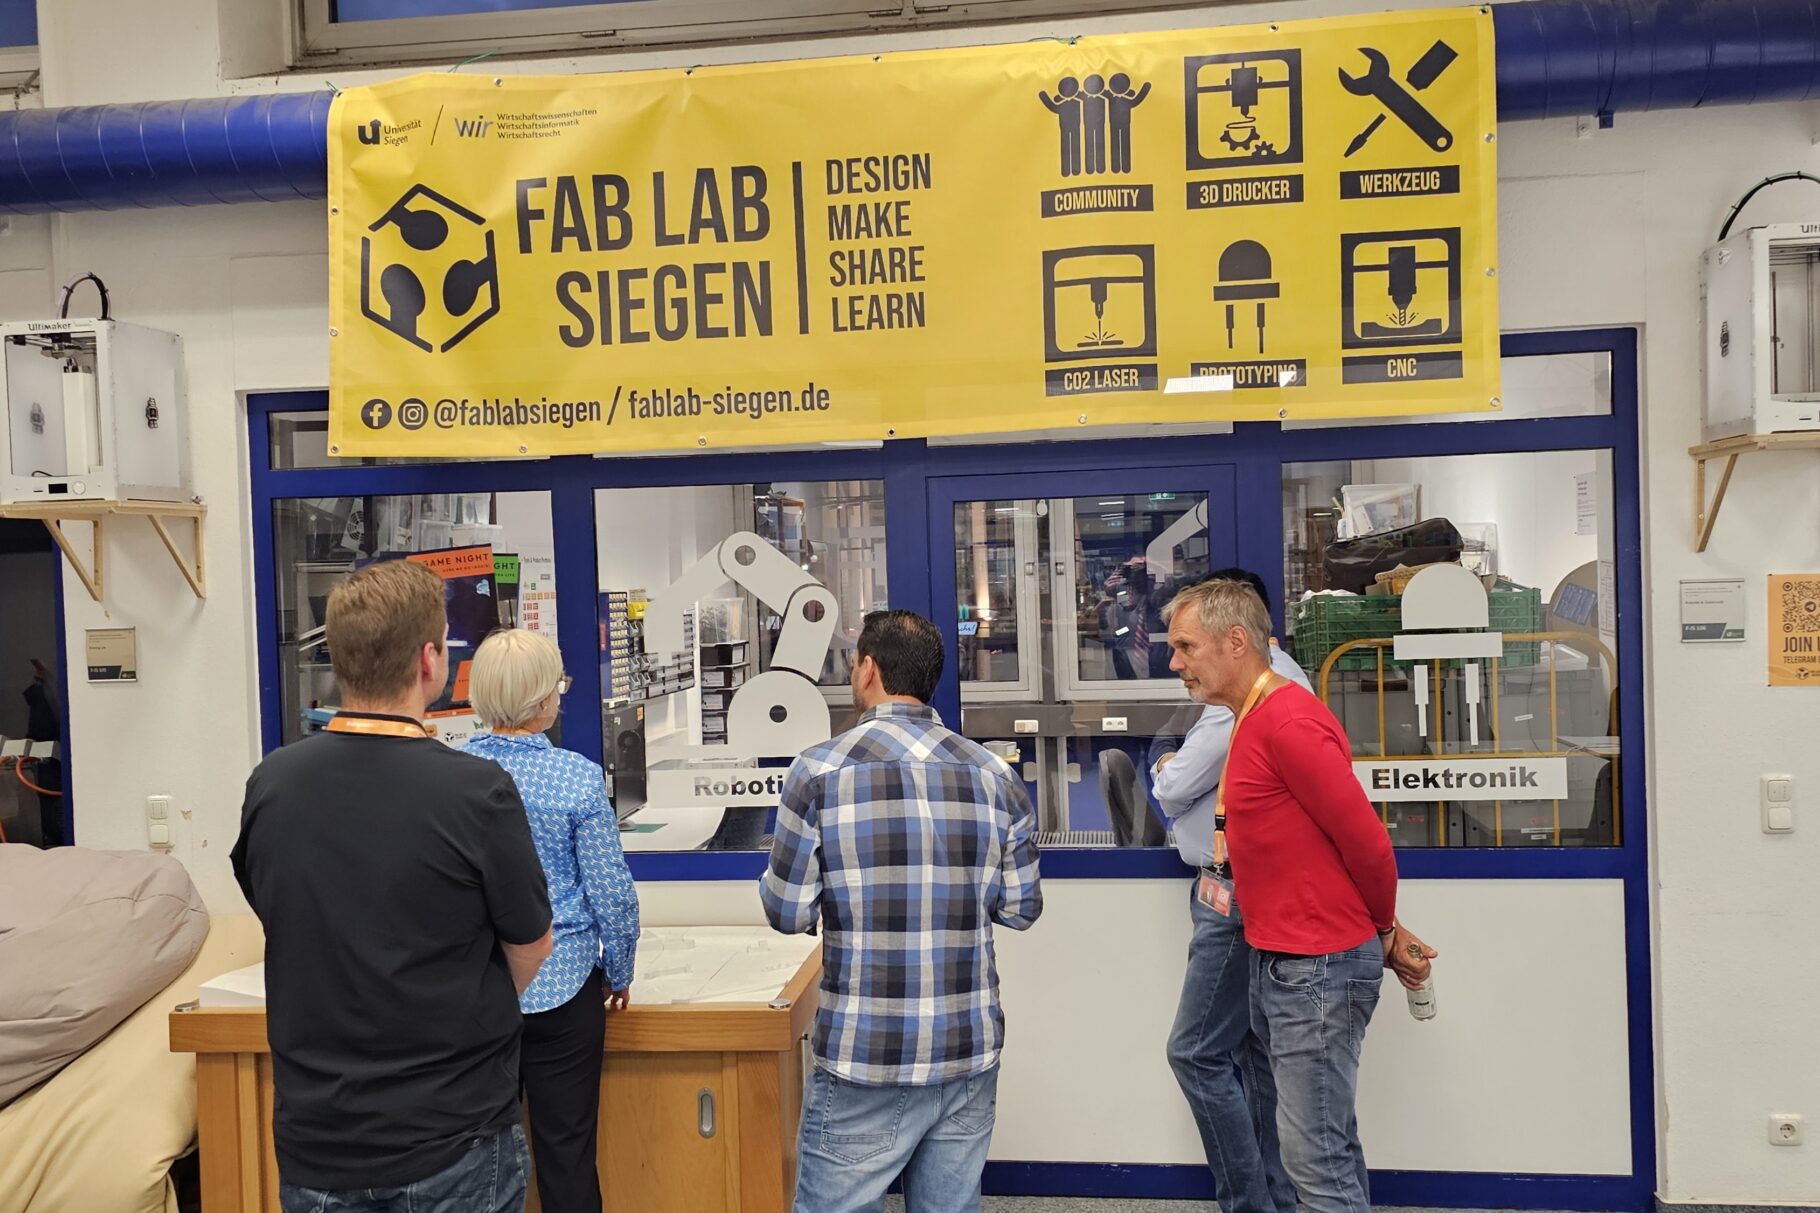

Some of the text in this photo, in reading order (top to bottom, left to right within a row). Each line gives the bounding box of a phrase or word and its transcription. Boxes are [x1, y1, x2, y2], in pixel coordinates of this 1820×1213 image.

[496, 108, 598, 122] Wirtschaftswissenschaften
[496, 118, 580, 131] Wirtschaftsinformatik
[383, 119, 422, 135] Universität
[496, 129, 561, 140] Wirtschaftsrecht
[383, 135, 409, 147] Siegen
[825, 152, 932, 196] DESIGN
[1359, 171, 1441, 194] WERKZEUG
[1053, 188, 1140, 212] COMMUNITY
[1199, 180, 1291, 204] 3D DRUCKER
[516, 164, 771, 255] FAB LAB
[827, 200, 912, 242] MAKE
[829, 245, 926, 287] SHARE
[555, 260, 774, 349] SIEGEN
[832, 292, 927, 333] LEARN
[27, 322, 72, 331] Ultimaker
[1063, 368, 1139, 391] CO2 LASER
[1386, 358, 1417, 378] CNC
[434, 396, 601, 430] @fablabsiegen
[628, 382, 831, 421] fablab-siegen.de
[455, 553, 489, 565] NIGHT
[493, 562, 515, 570] GHT
[1783, 636, 1812, 653] JOIN
[694, 774, 784, 797] Roboti
[1371, 766, 1539, 790] Elektronik
